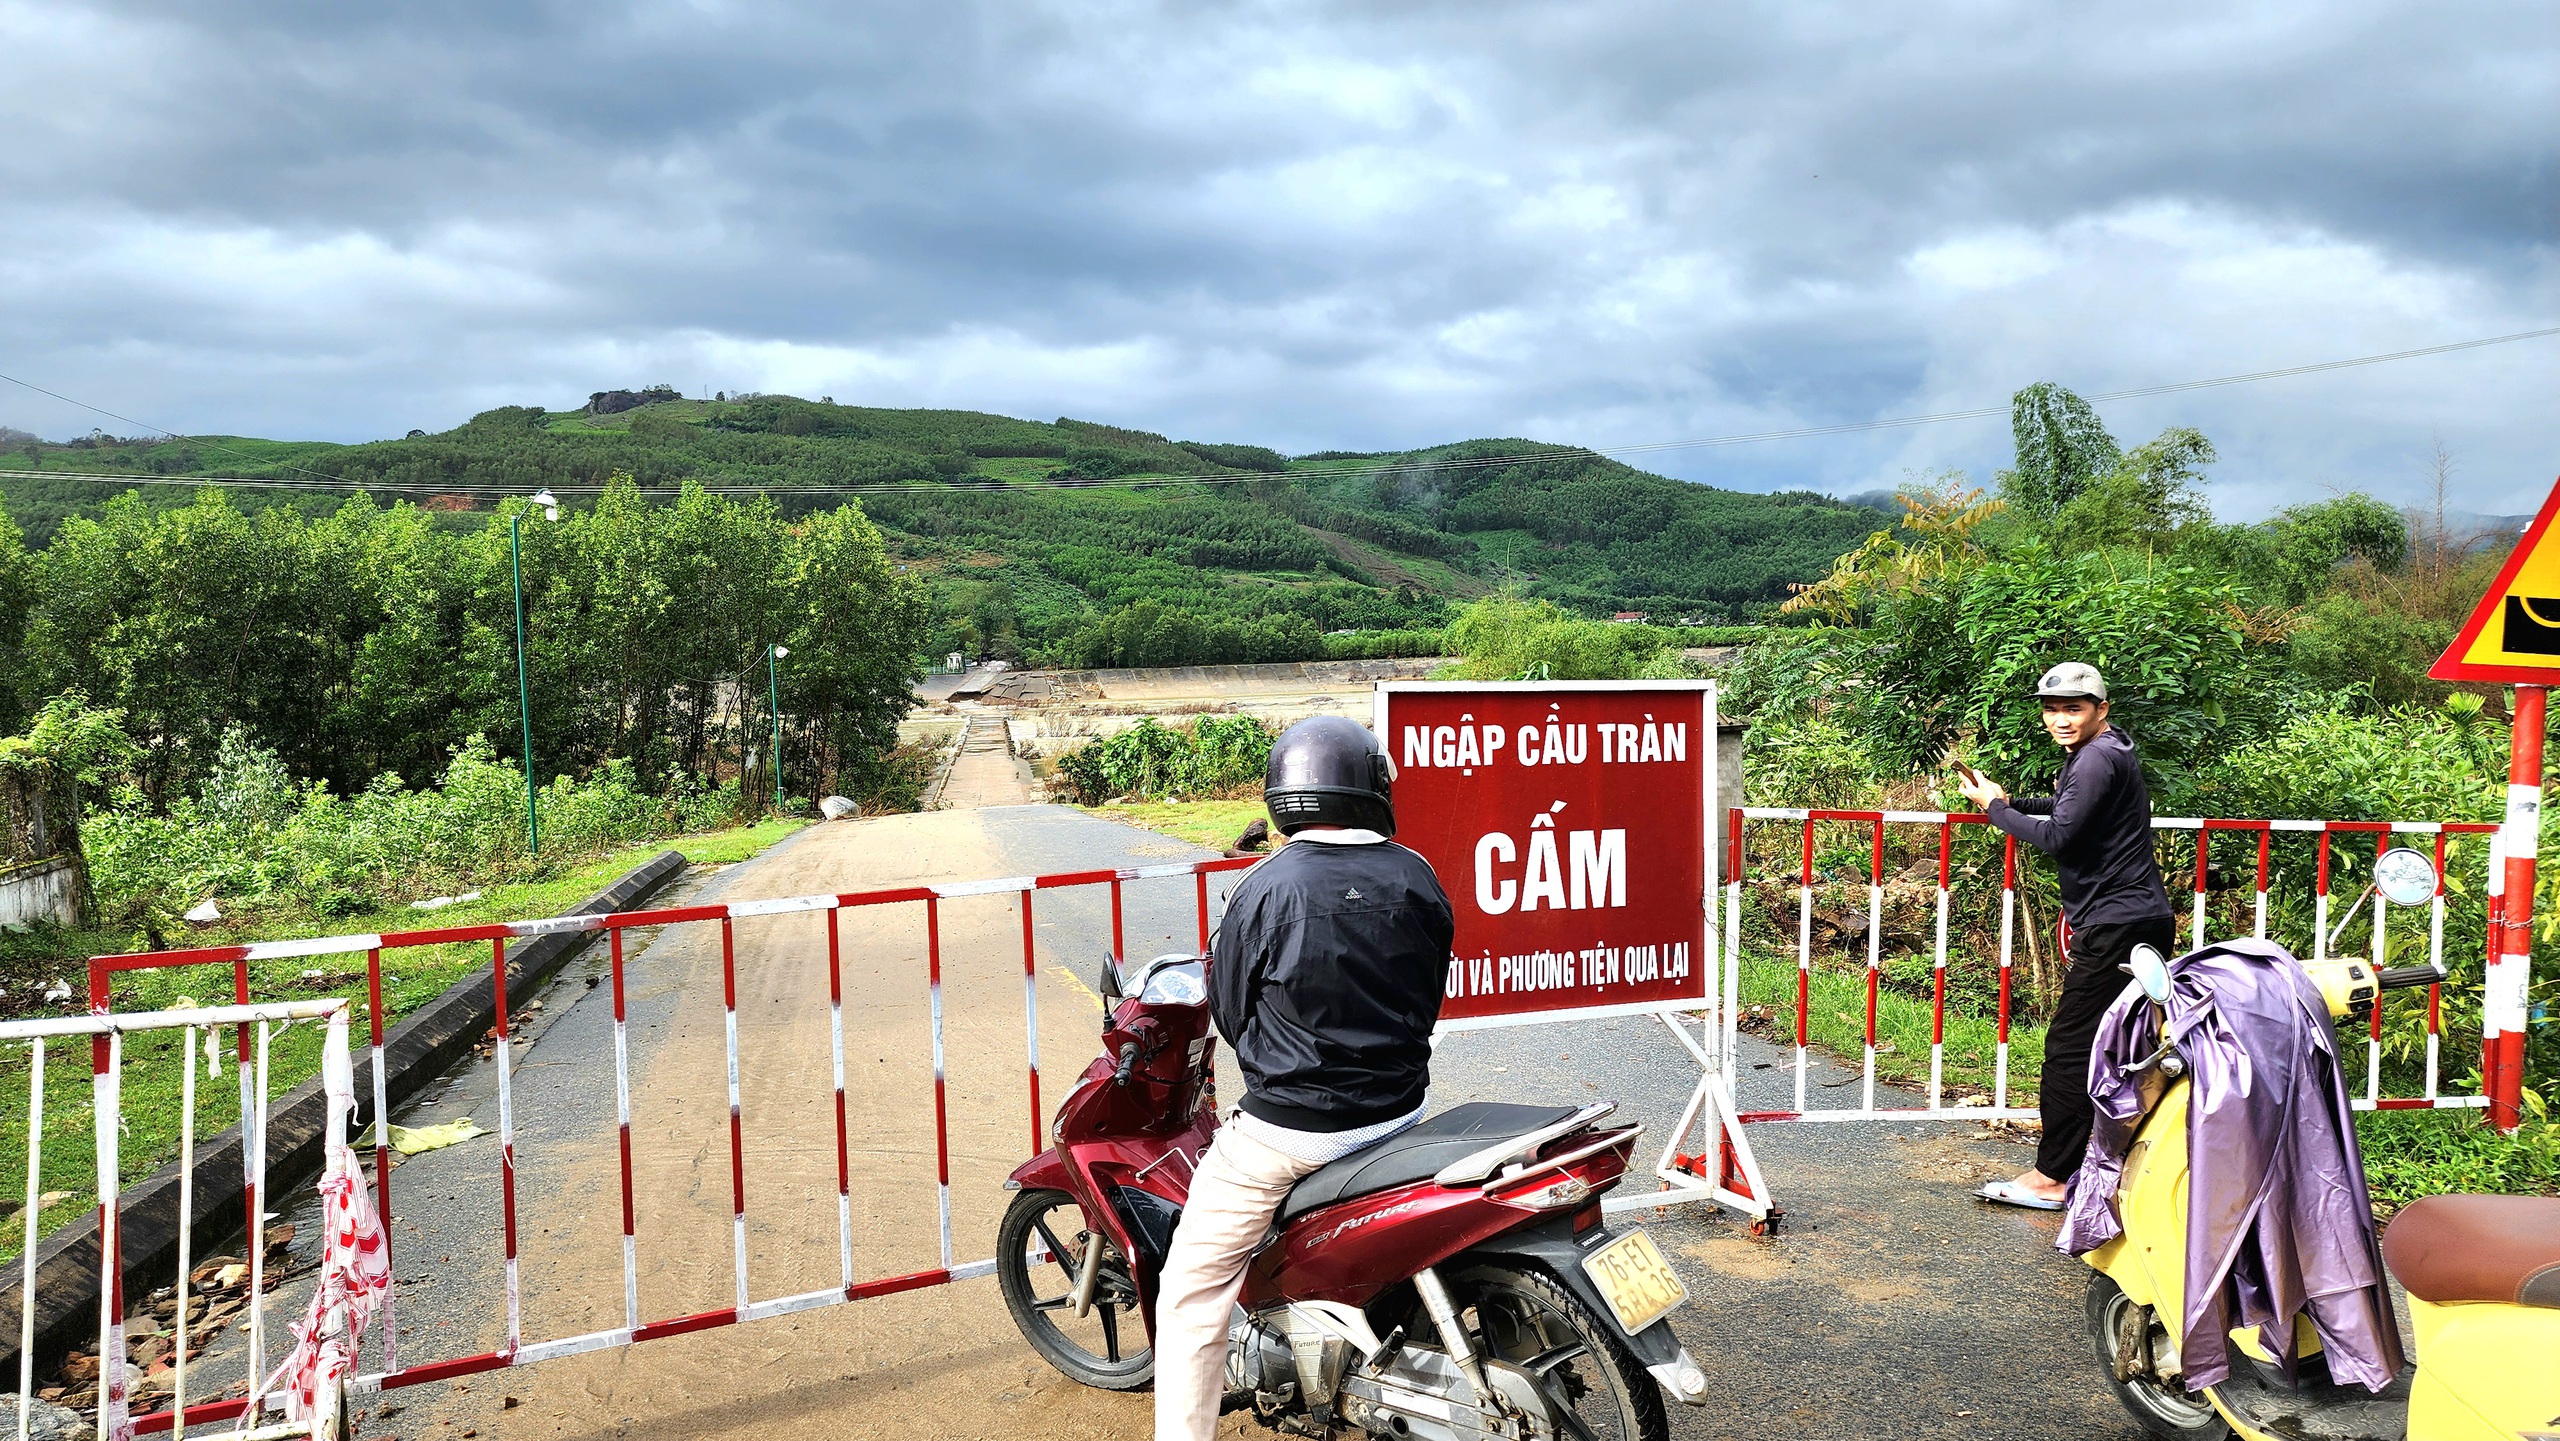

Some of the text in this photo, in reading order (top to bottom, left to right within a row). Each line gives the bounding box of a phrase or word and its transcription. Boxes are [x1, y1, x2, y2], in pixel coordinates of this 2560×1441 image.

[1404, 702, 1686, 776] NGẬP CẦU TRÀN
[1474, 800, 1627, 915] CẤM
[1445, 940, 1689, 999] ỜI VÀ PHƯƠNG TIỆN QUA LẠI
[1596, 1239, 1653, 1290] 76-E1
